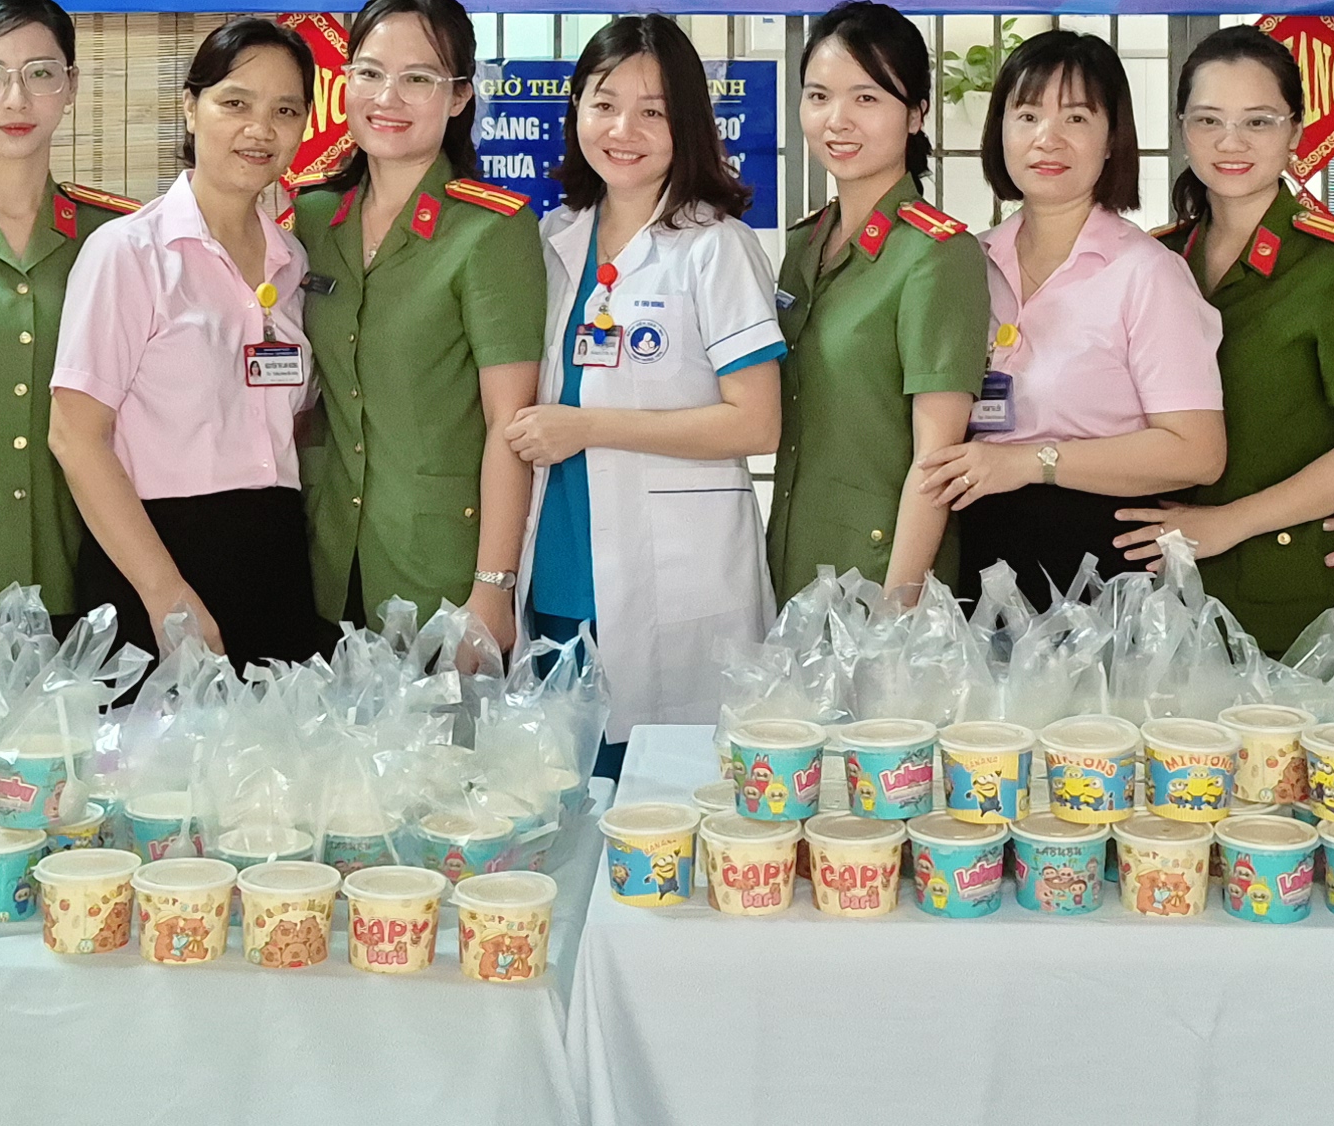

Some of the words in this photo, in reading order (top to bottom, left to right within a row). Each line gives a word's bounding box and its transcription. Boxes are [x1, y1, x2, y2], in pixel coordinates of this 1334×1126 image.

[479, 74, 523, 96] GIỜ
[527, 75, 572, 96] THĂ
[1164, 755, 1234, 774] MINIONS
[721, 860, 794, 890] CAPY
[820, 862, 897, 890] CAPY
[352, 917, 432, 946] CAPY
